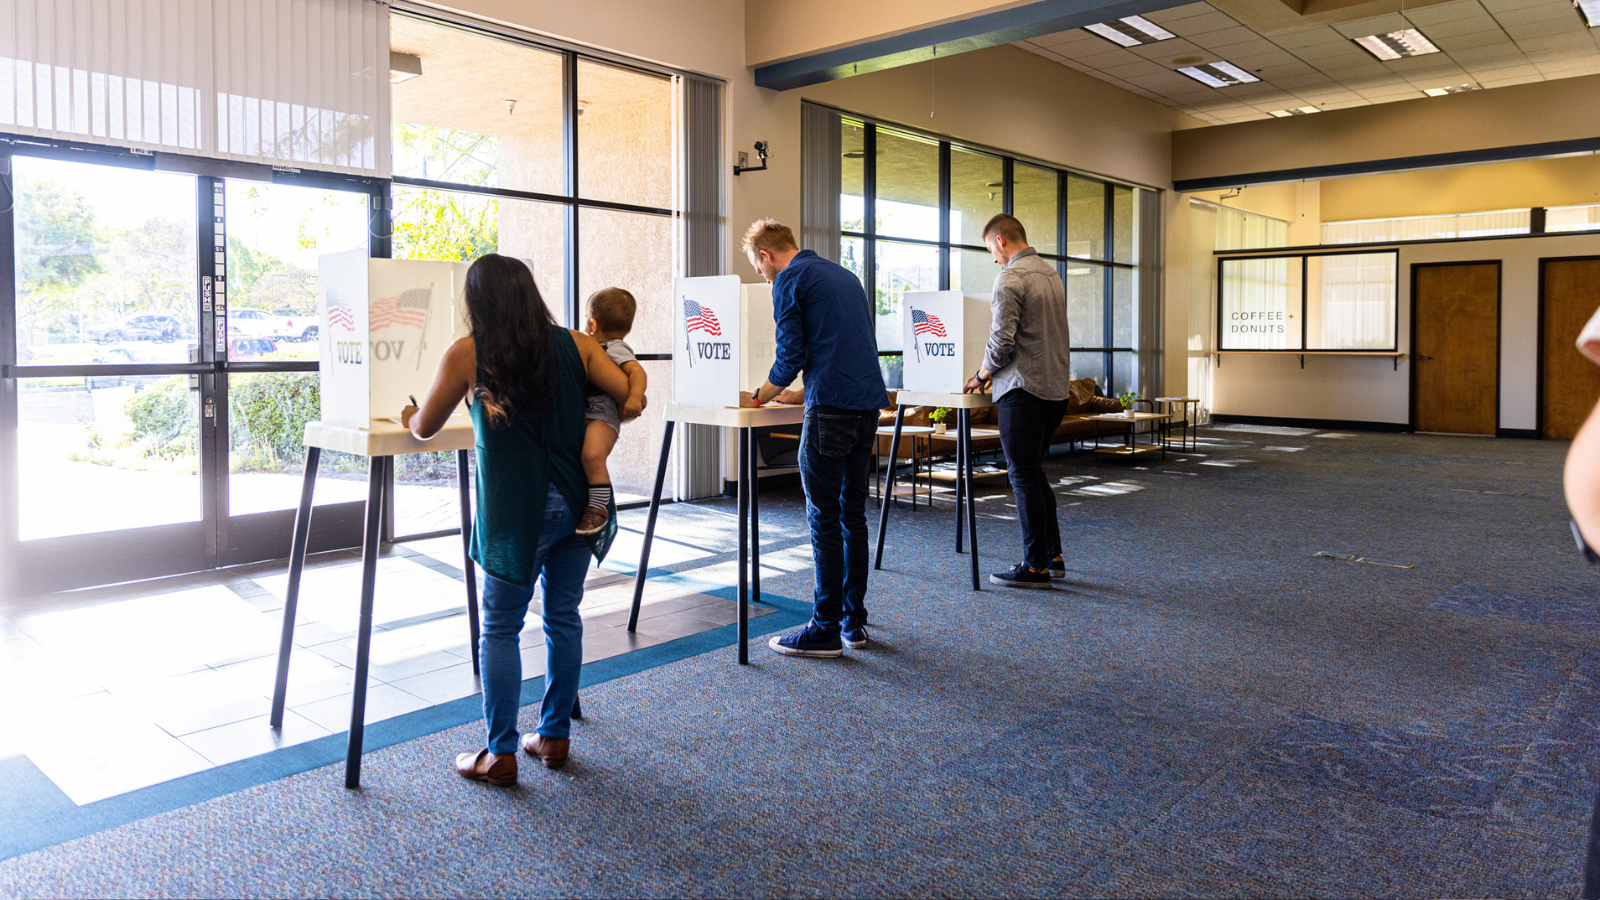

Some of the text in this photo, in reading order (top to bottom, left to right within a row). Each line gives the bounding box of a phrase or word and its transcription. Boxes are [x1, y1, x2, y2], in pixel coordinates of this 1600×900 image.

[1231, 311, 1283, 321] COFFEE
[1231, 324, 1285, 334] DONUTS
[336, 341, 363, 365] VOTE
[696, 342, 731, 360] VOTE
[924, 342, 956, 357] VOTE
